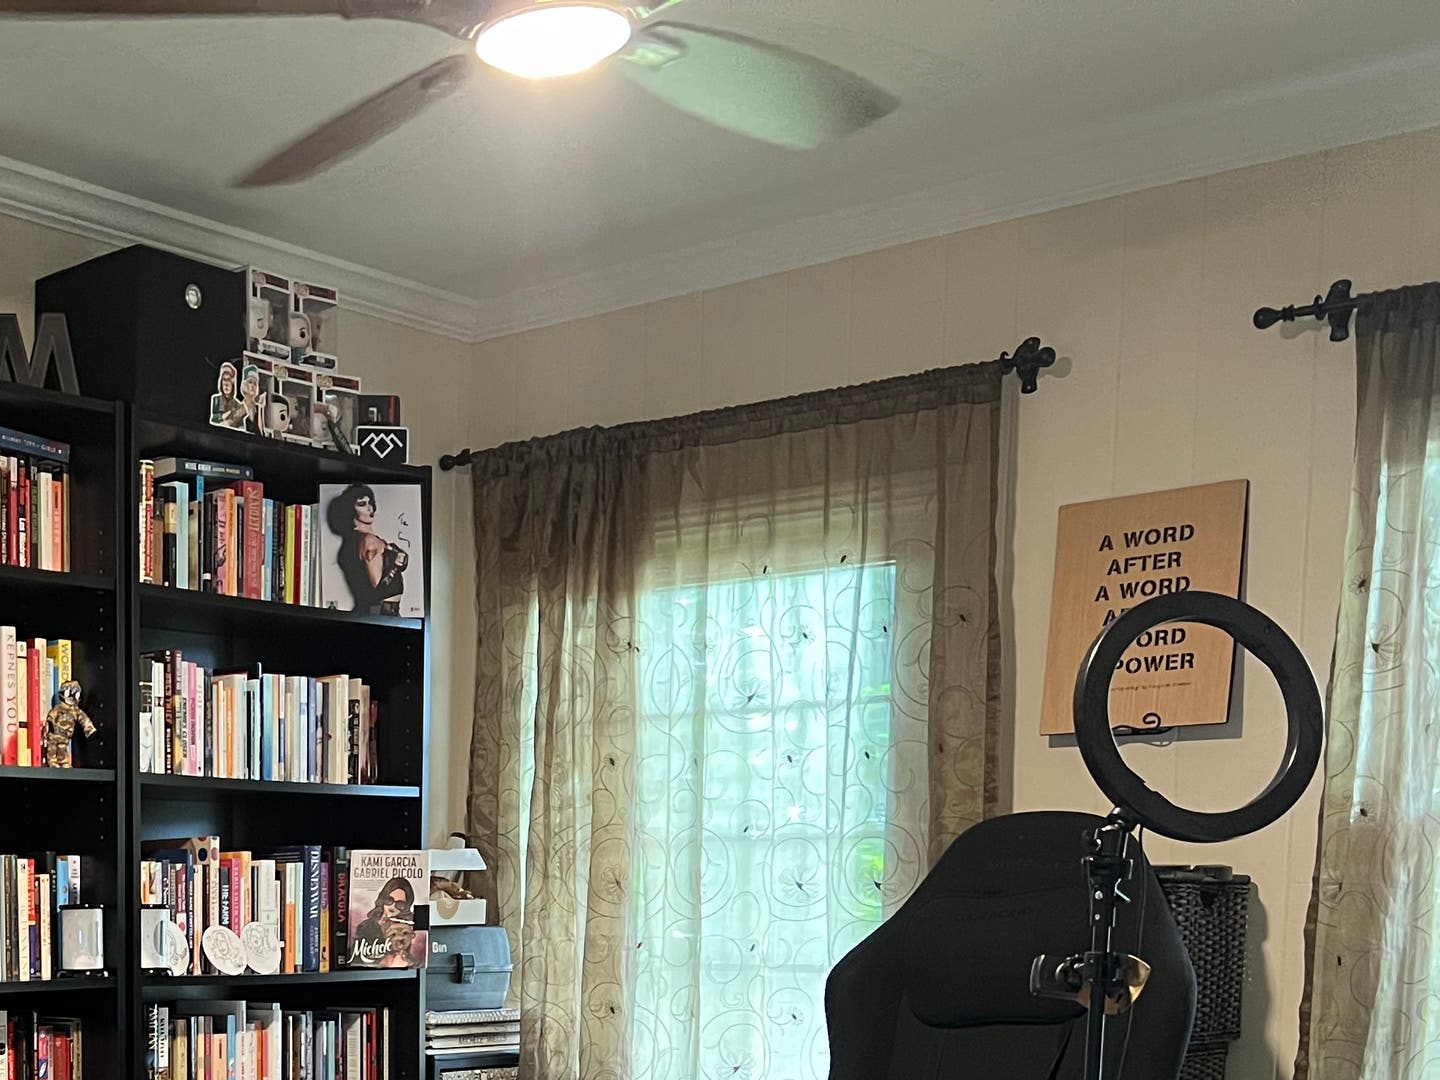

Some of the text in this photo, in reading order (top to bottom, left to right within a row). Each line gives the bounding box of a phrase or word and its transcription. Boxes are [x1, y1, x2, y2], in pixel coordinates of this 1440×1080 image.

[1099, 524, 1195, 552] A WORD
[1106, 550, 1182, 576] AFTER
[1095, 575, 1191, 602] A WORD
[6, 635, 16, 733] KEPNES YOU
[353, 867, 424, 879] GABRIEL PICOLO
[361, 856, 417, 867] KAMI GARCIA
[309, 850, 322, 919] DISNEYWAR
[337, 872, 347, 923] DRACULA
[222, 883, 230, 925] THE FARM
[347, 937, 392, 964] Michele
